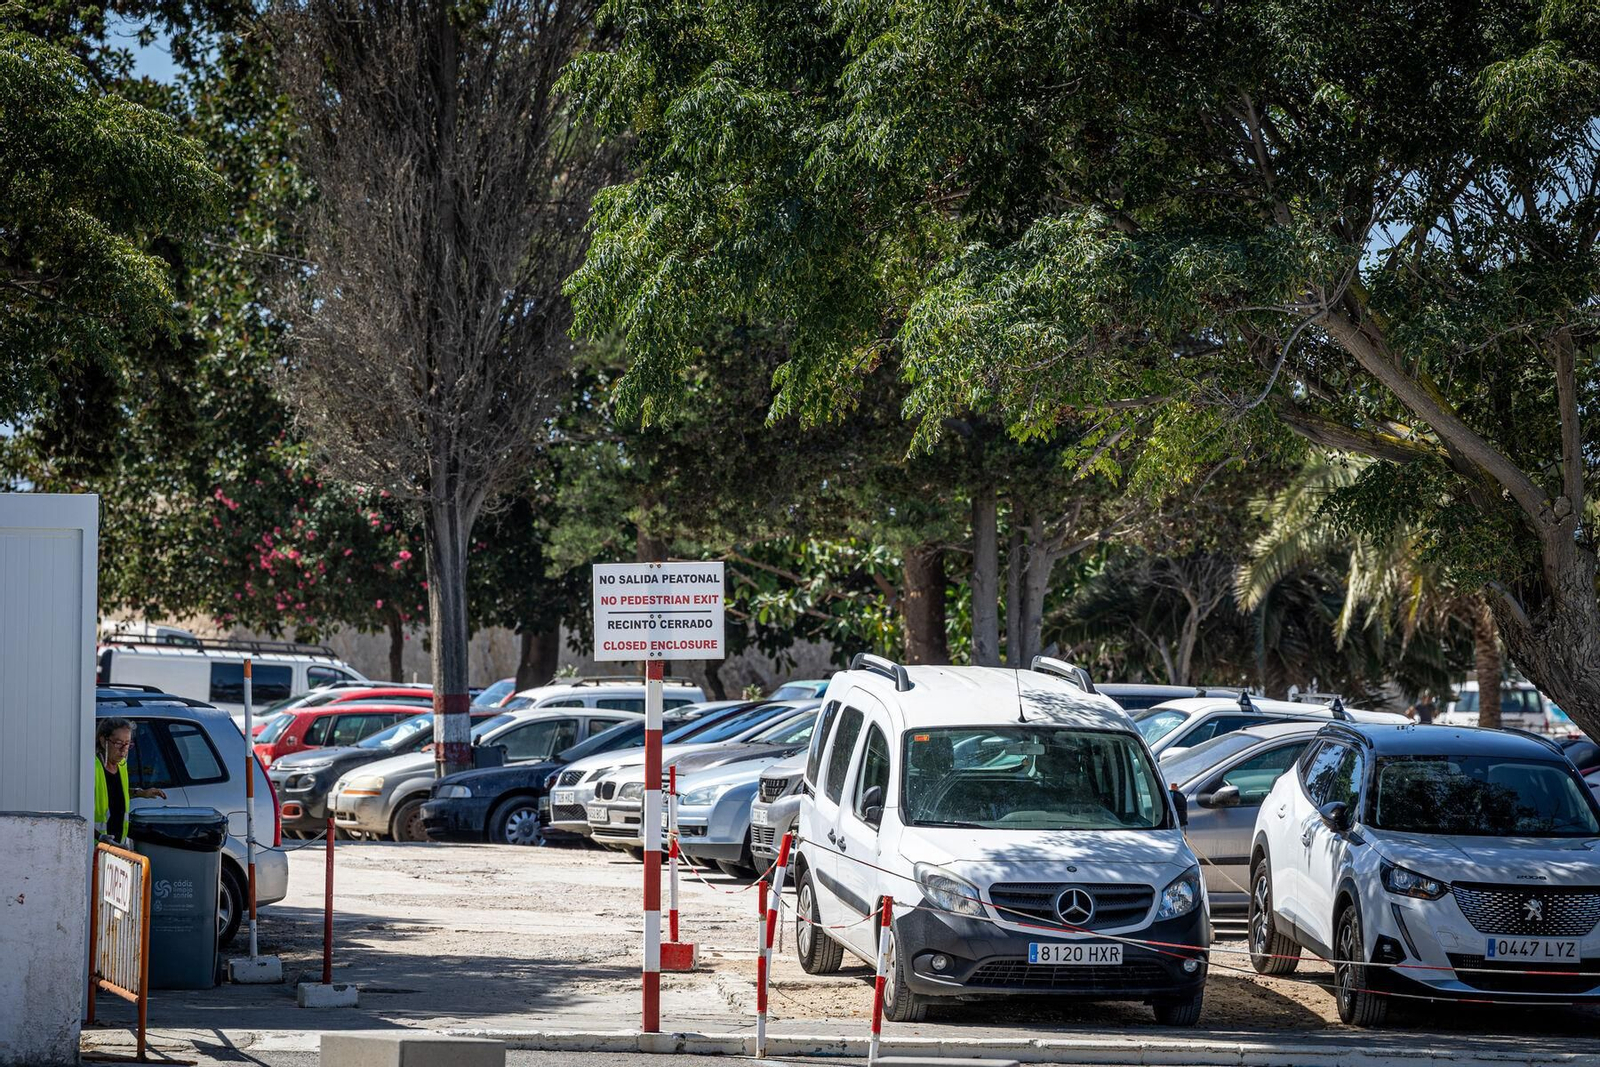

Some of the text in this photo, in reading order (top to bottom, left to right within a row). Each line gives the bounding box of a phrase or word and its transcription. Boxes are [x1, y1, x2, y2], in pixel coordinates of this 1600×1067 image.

[600, 574, 720, 584] NO SALIDA PEATONAL
[601, 595, 719, 605] NO PEDESTRIAN EXIT
[608, 619, 713, 629] RECINTO CERRADO
[603, 640, 718, 650] CLOSED ENCLOSURE
[1041, 946, 1083, 962] 8120
[1088, 946, 1119, 962] HXR
[1498, 940, 1576, 958] 0447 LYZ
